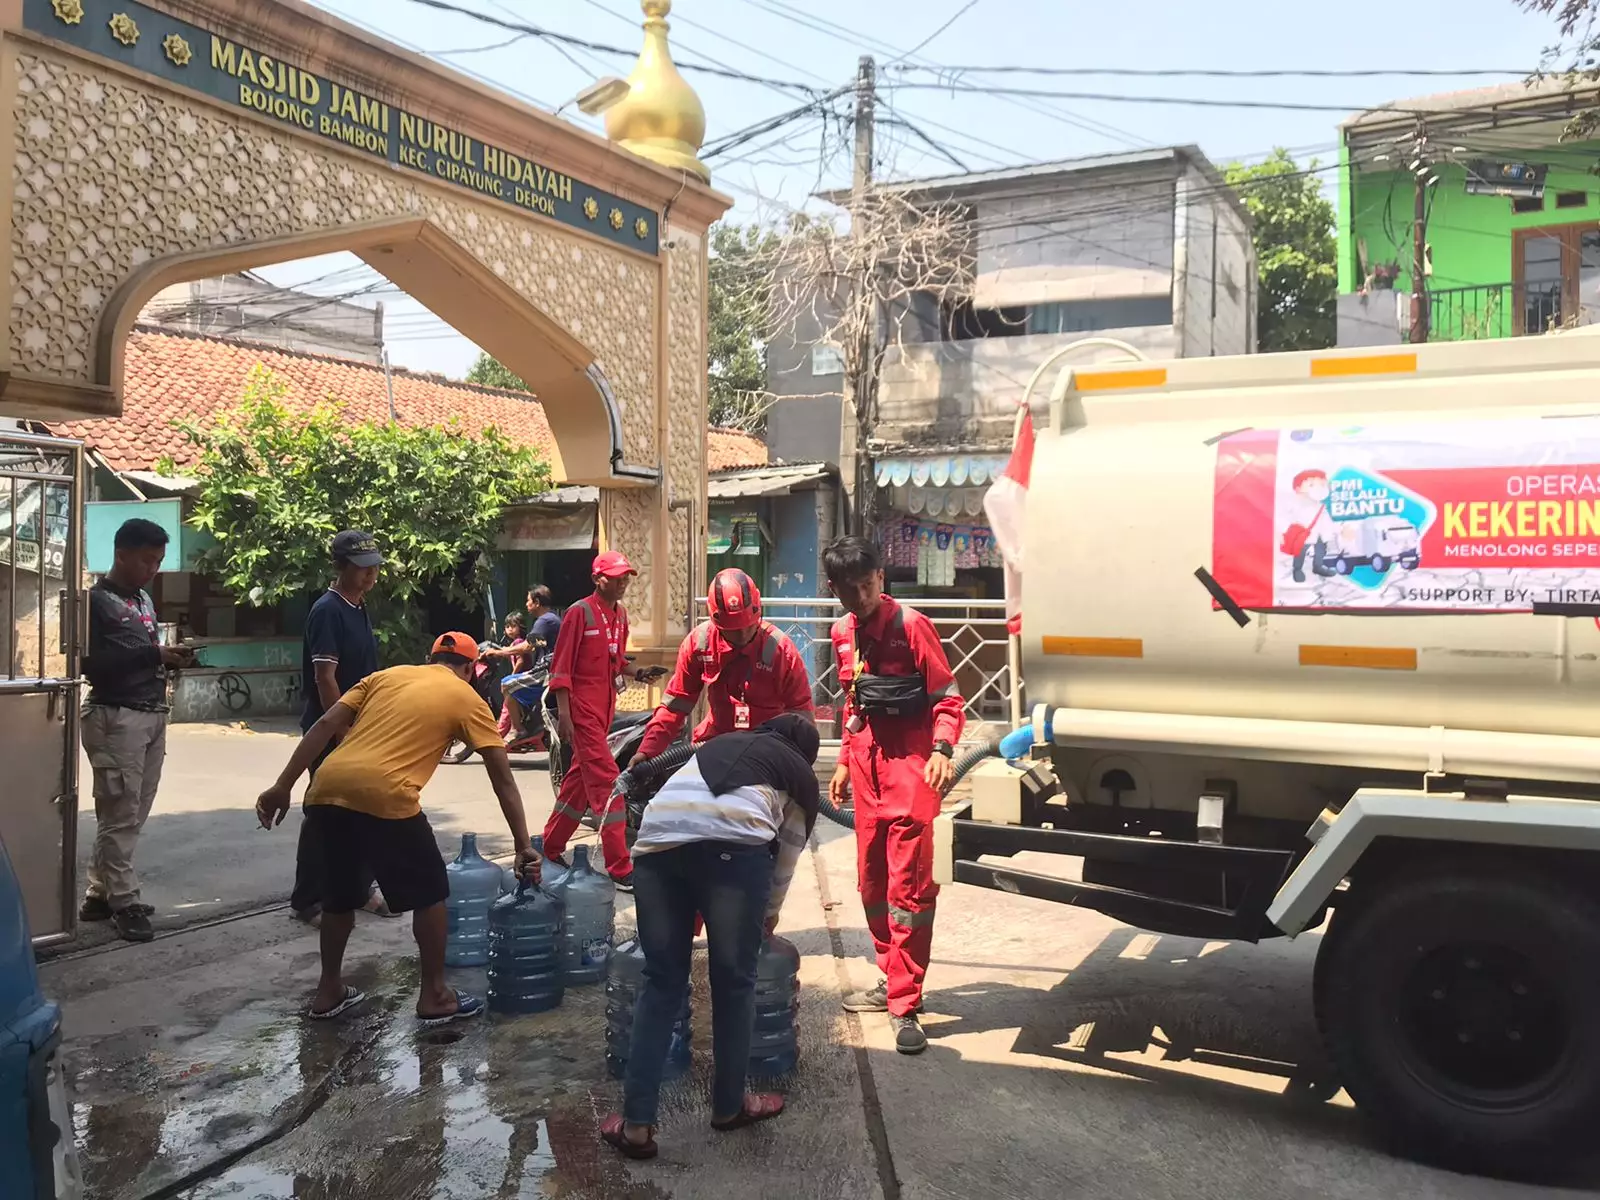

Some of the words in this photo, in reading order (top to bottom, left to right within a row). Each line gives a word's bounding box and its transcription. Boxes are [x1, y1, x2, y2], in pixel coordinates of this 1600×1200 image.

[211, 35, 320, 104] MASJID
[328, 84, 389, 134] JAMI
[399, 112, 476, 167] NURUL
[483, 145, 573, 202] HIDAYAH
[239, 84, 314, 128] BOJONG
[319, 115, 388, 155] BAMBON
[399, 145, 431, 172] KEC.
[435, 160, 503, 198] CIPAYUNG
[515, 188, 556, 216] DEPOK
[1331, 479, 1363, 493] PMI
[1507, 475, 1600, 496] OPERA
[1331, 488, 1388, 503] SELALU
[1331, 499, 1405, 517] BANTU
[1443, 502, 1600, 538] KEKERIN
[1444, 544, 1547, 557] MENOLONG
[1408, 588, 1495, 602] SUPPORT
[1504, 589, 1536, 603] BY:
[1545, 590, 1600, 603] TIRTA
